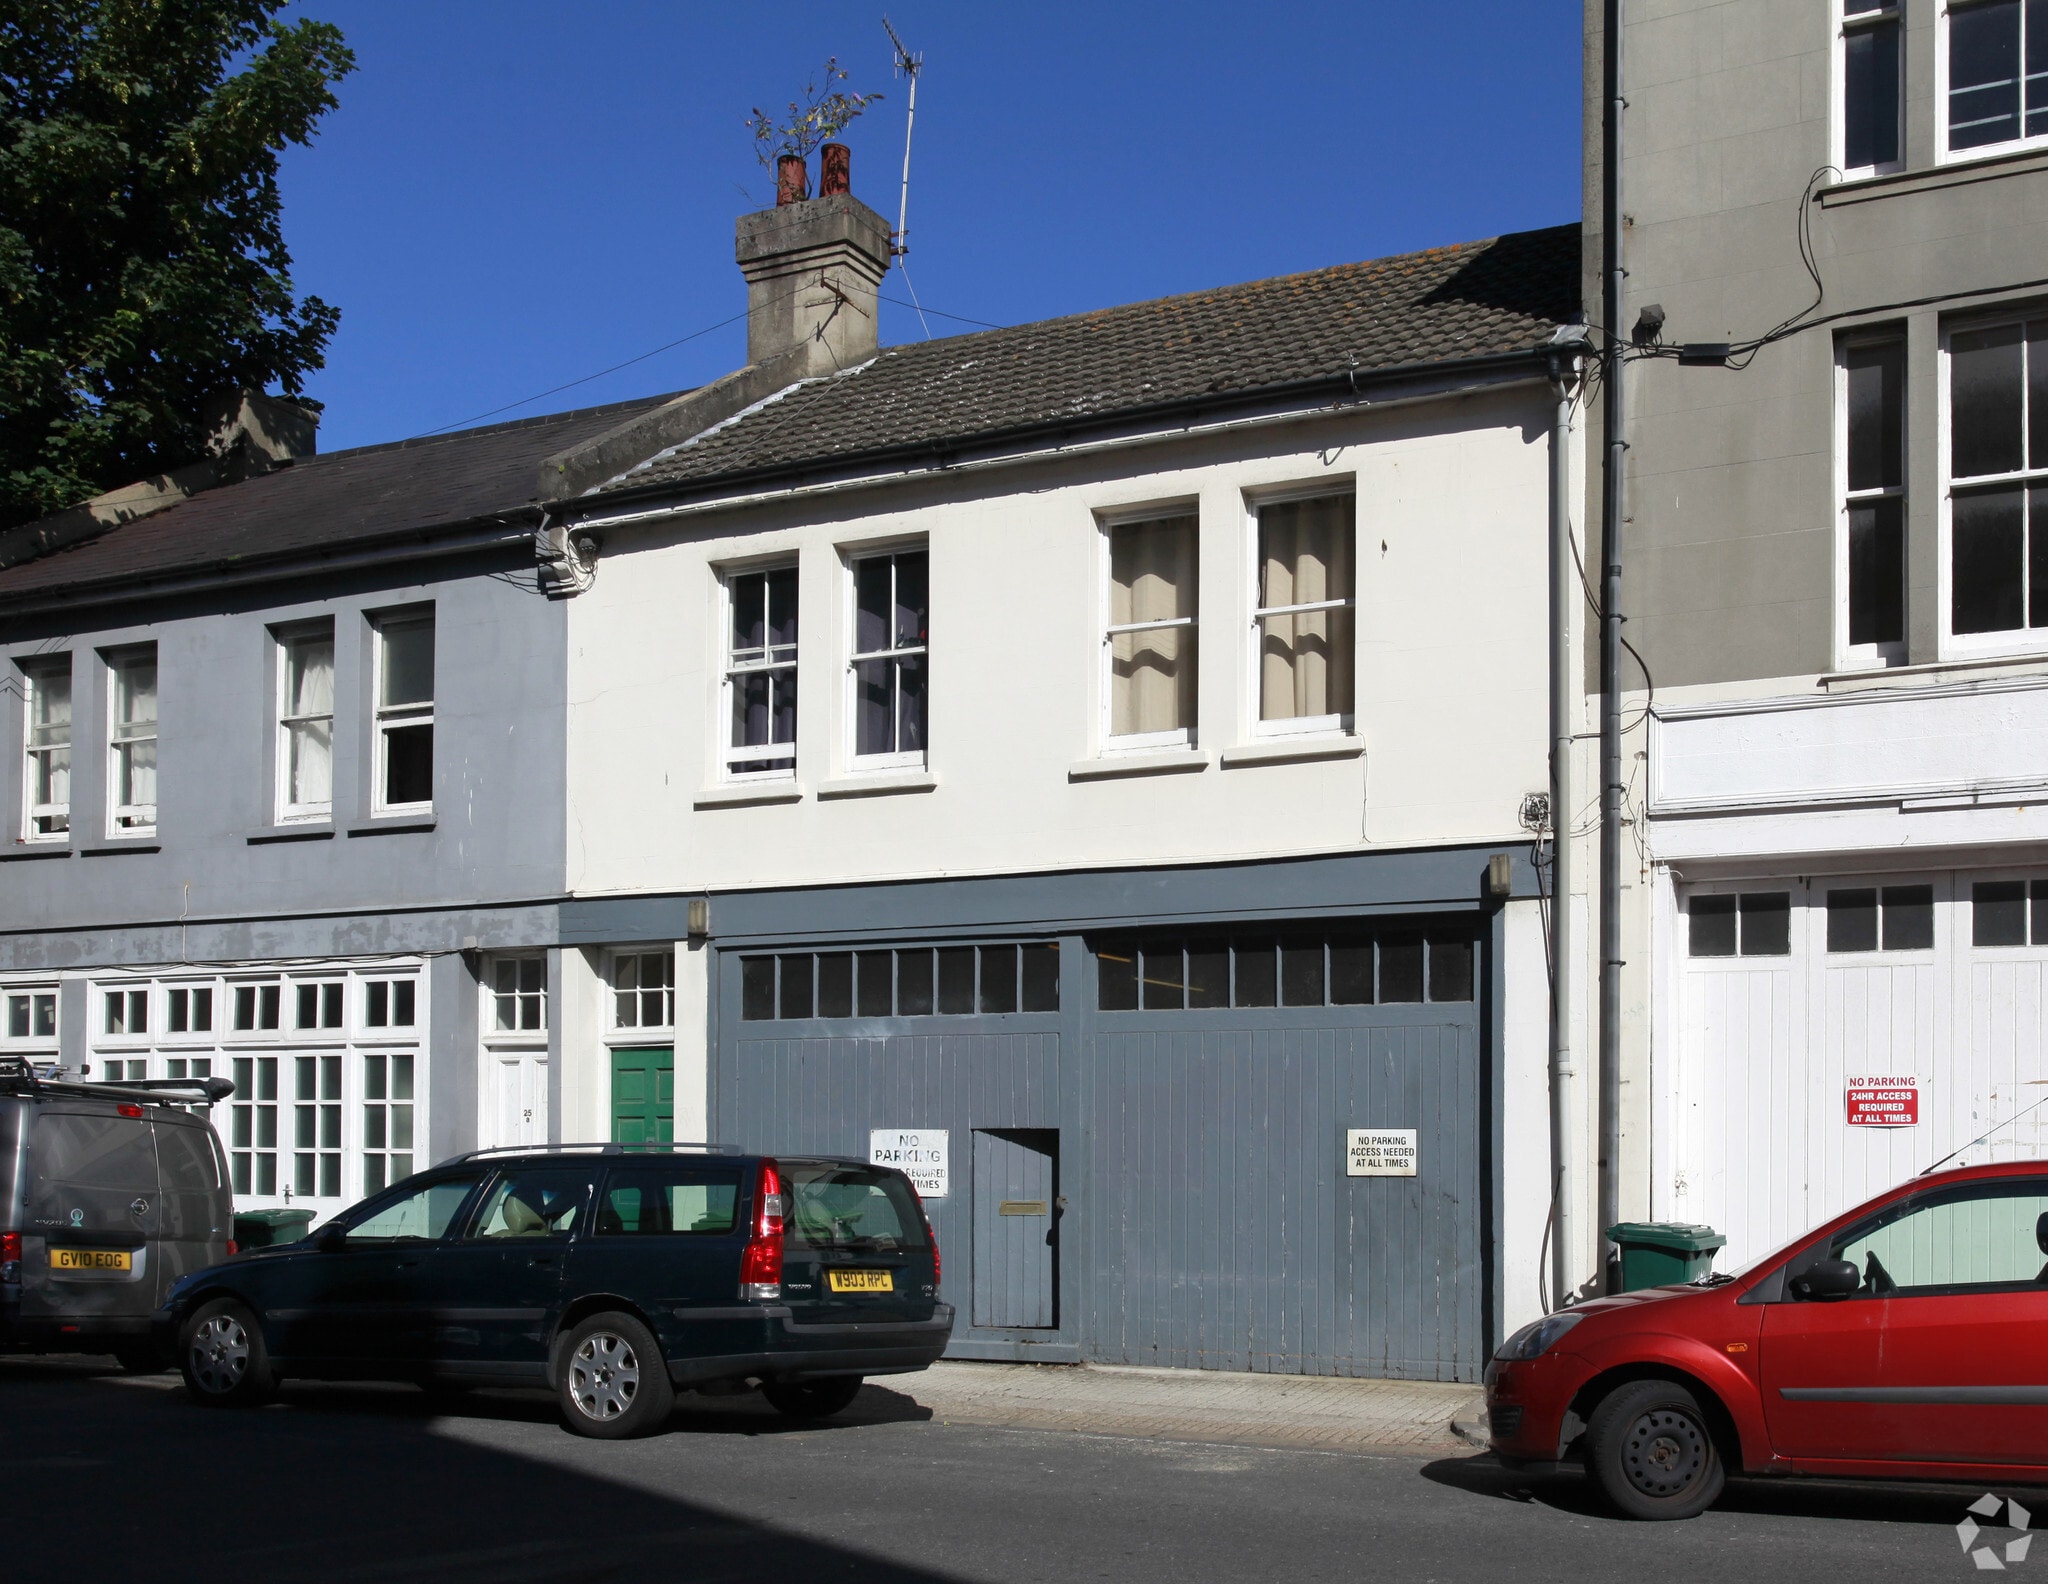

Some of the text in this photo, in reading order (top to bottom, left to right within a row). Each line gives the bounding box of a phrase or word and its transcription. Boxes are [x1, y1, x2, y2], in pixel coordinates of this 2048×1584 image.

[1849, 1076, 1916, 1087] NO PARKING
[1851, 1091, 1912, 1101] 24HR ACCESS
[1858, 1103, 1905, 1112] REQUIRED
[523, 1109, 533, 1117] 25
[1851, 1114, 1912, 1123] AT ALL TIMES
[899, 1134, 919, 1147] NO
[1358, 1136, 1407, 1146] NO PARKING
[875, 1149, 941, 1163] PARKING
[1350, 1147, 1415, 1157] ACCESS NEEDED
[1355, 1158, 1409, 1168] AT ALL TIMES
[60, 1252, 122, 1267] GV10 EOG
[834, 1271, 888, 1288] W903 RPC
